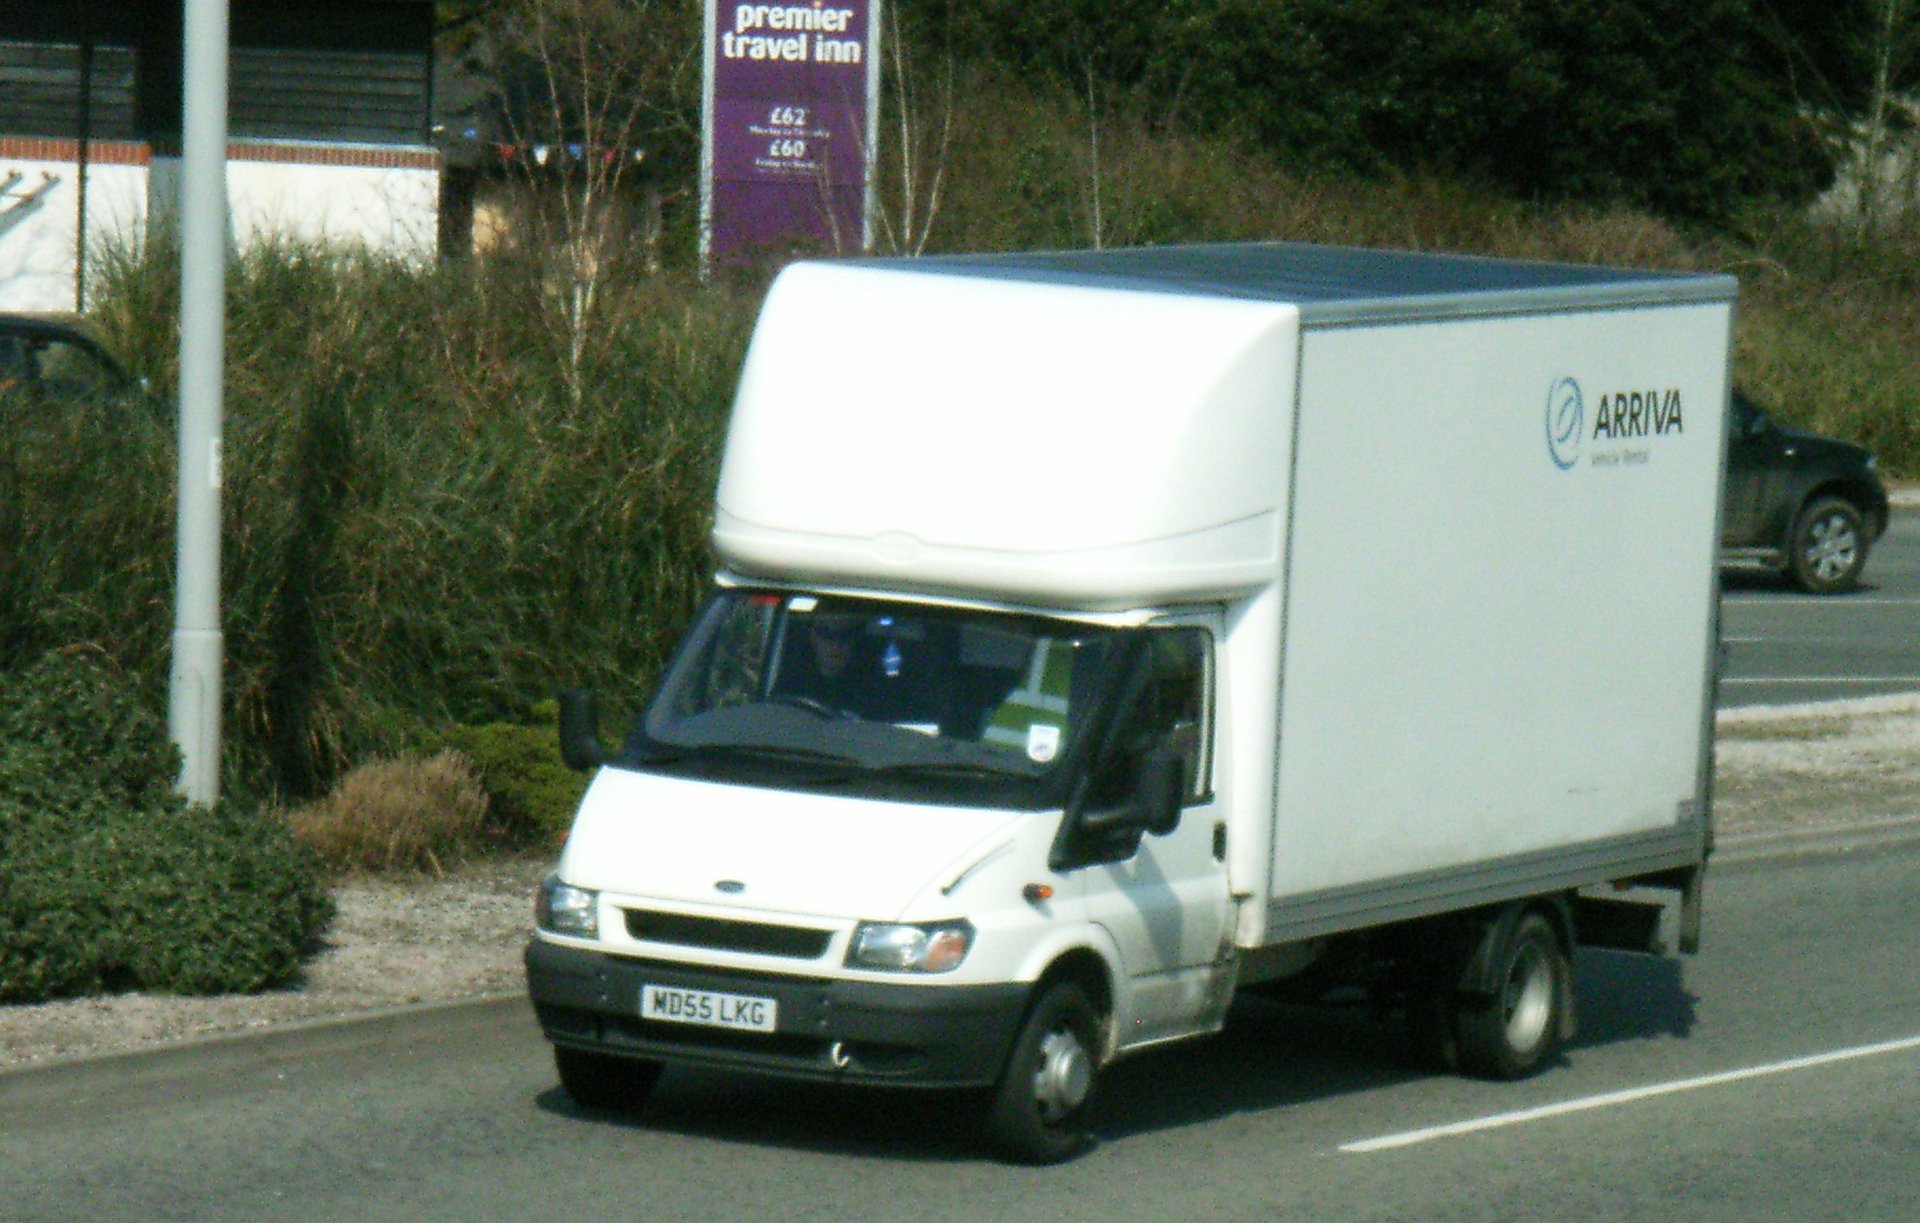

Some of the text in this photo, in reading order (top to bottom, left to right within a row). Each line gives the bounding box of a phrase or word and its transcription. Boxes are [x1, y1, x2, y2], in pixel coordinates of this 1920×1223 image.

[736, 1, 853, 33] premier
[722, 31, 862, 63] travel inn
[770, 107, 806, 125] £62
[769, 139, 805, 158] £60
[1593, 388, 1683, 440] ARRIVA
[720, 998, 765, 1025] LKG
